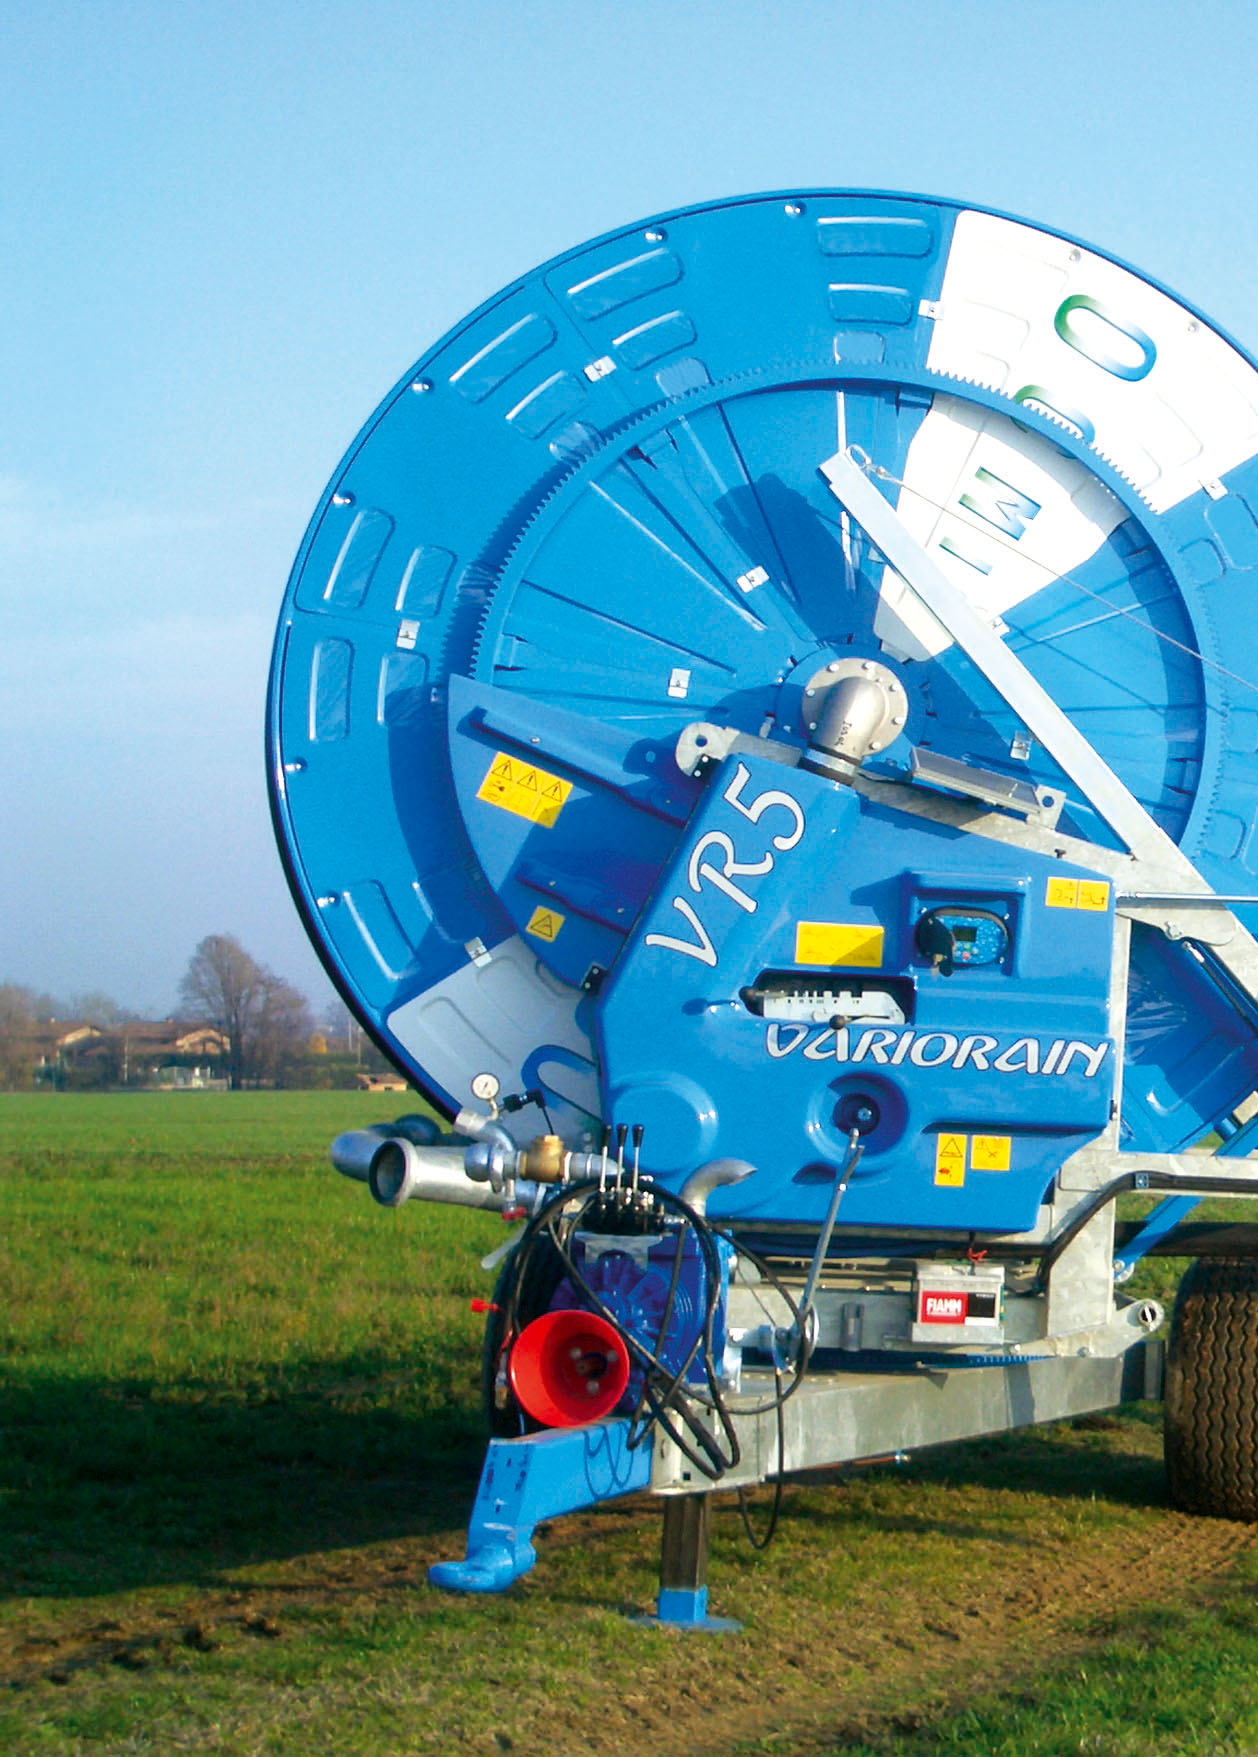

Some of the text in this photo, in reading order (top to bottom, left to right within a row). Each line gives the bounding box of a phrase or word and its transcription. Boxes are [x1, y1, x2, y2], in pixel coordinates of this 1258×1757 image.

[645, 761, 806, 968] VR5
[766, 1023, 1108, 1077] VARIORAIN
[926, 1297, 962, 1314] FIAMM
